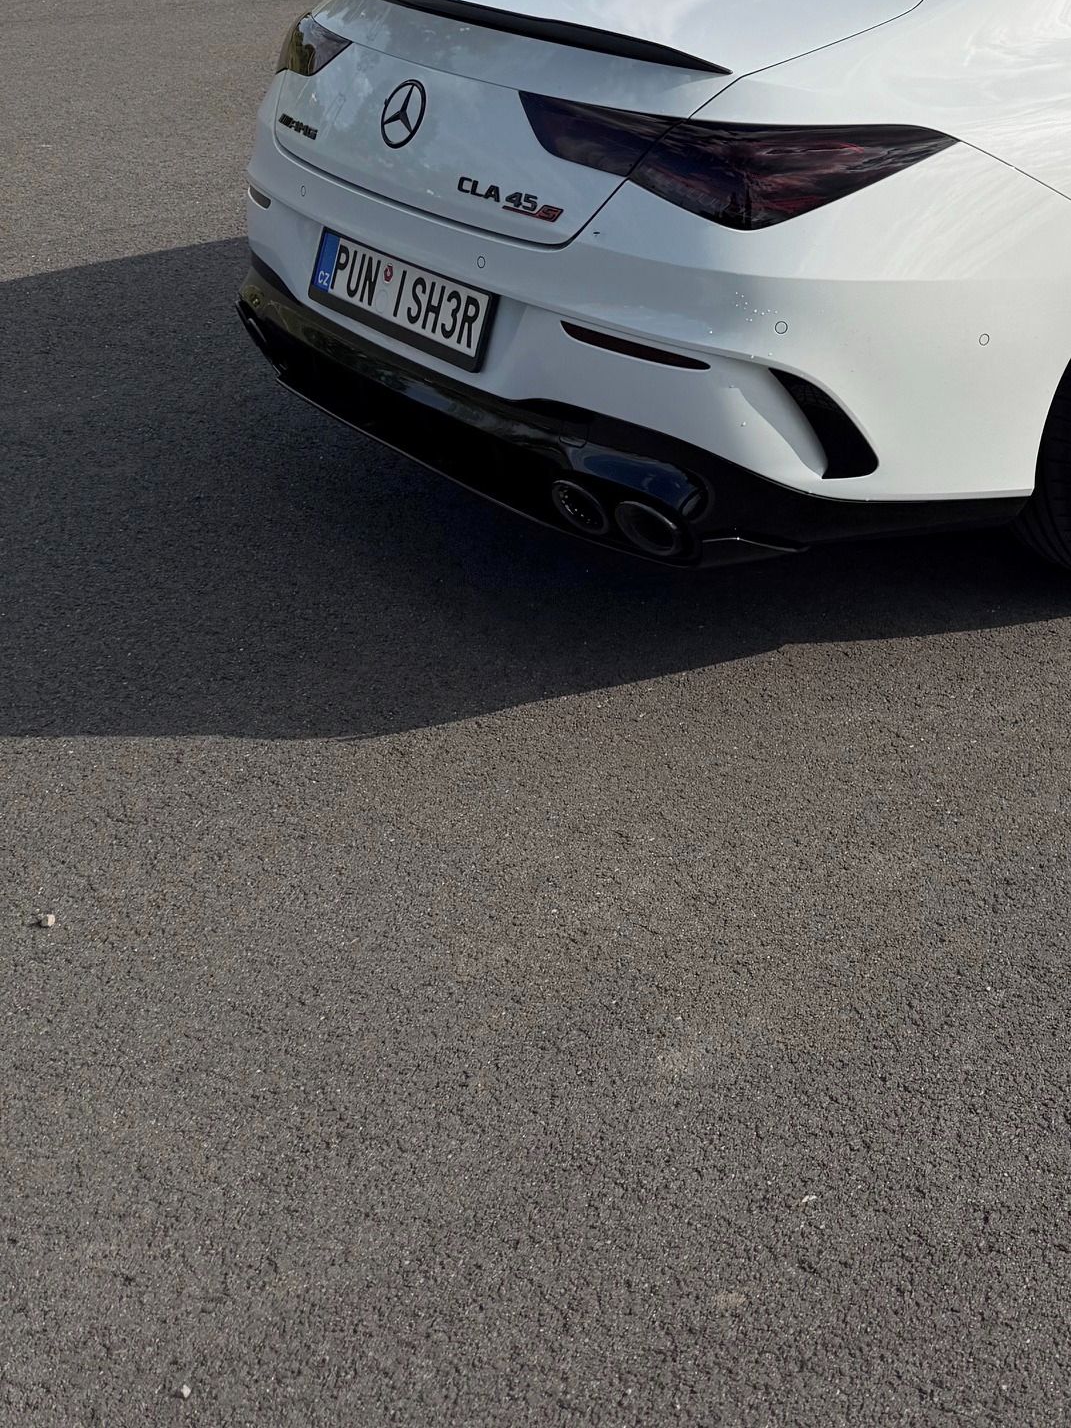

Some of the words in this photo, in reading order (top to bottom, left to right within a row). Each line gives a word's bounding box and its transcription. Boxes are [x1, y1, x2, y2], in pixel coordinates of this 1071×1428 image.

[457, 176, 500, 203] CLA
[317, 270, 329, 286] CZ
[330, 244, 382, 307] PUN
[392, 270, 481, 349] ISH3R
